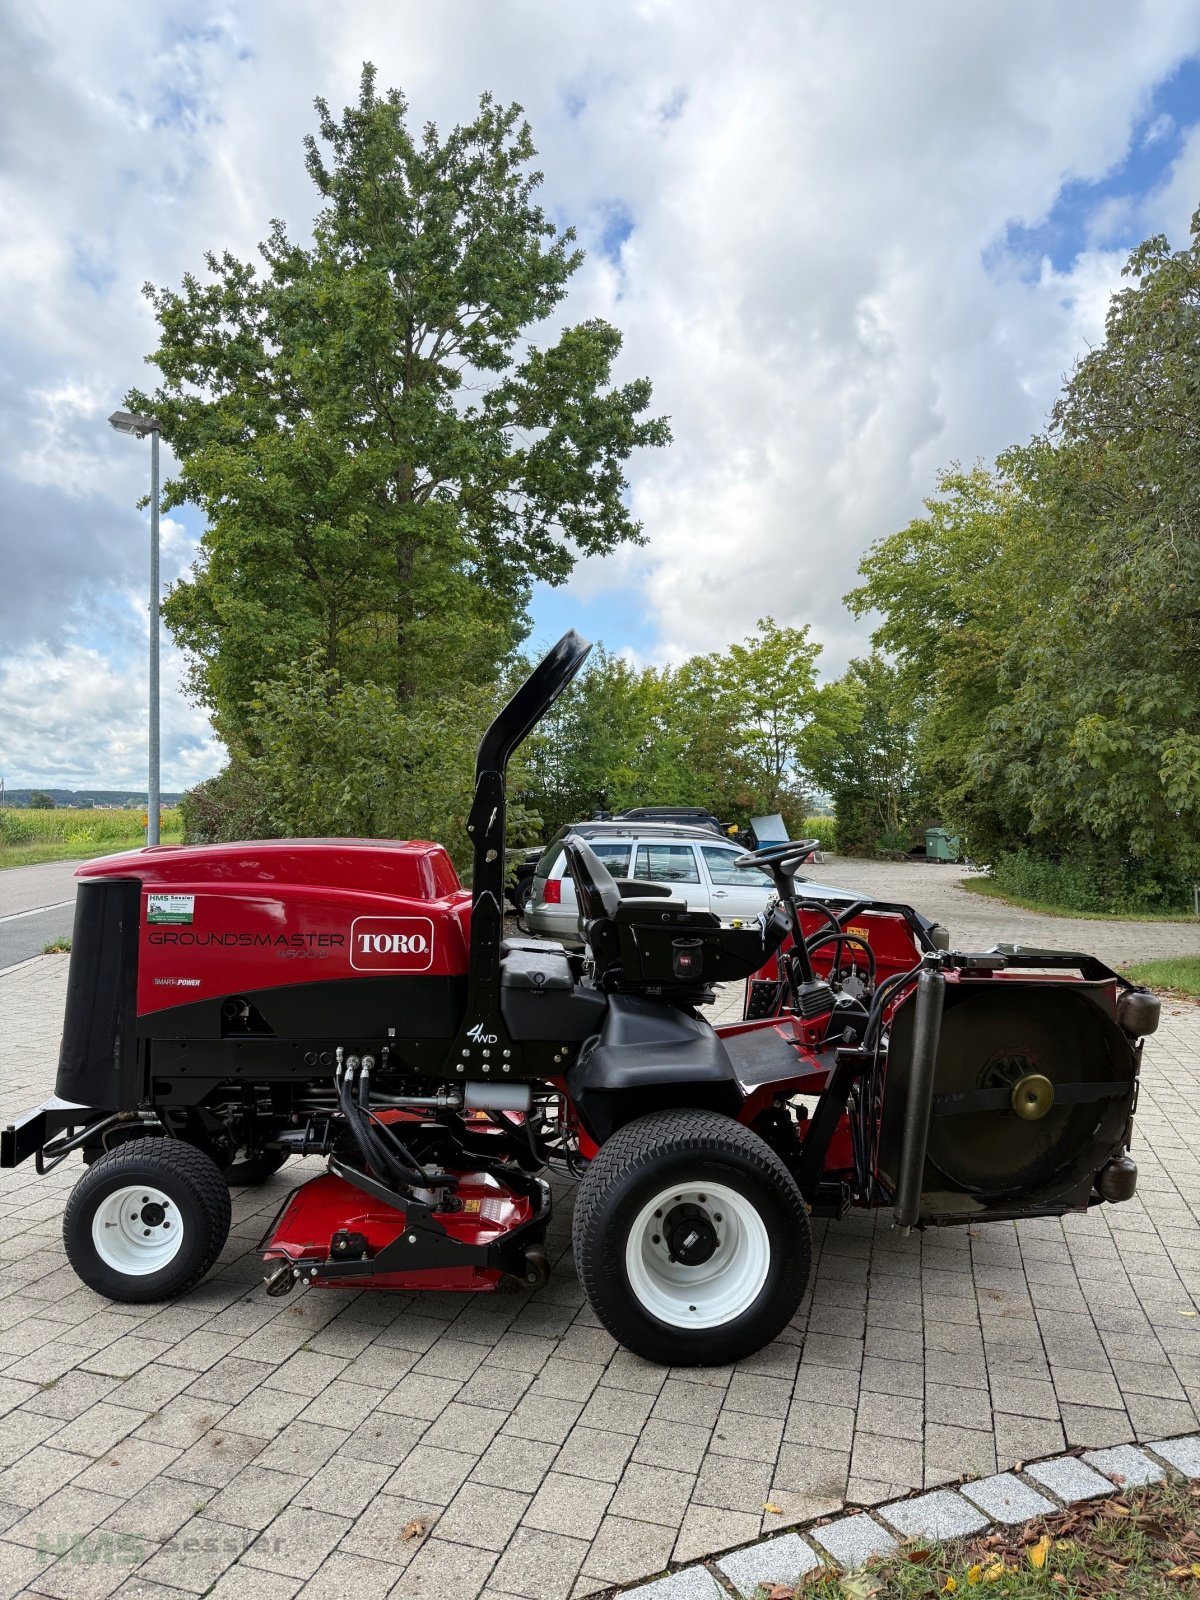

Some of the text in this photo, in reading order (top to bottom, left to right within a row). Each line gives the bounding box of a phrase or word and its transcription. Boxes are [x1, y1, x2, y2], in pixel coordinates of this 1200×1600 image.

[149, 933, 344, 946] GROUNDSMASTER
[357, 934, 426, 953] TORO
[466, 1022, 498, 1044] 4WD
